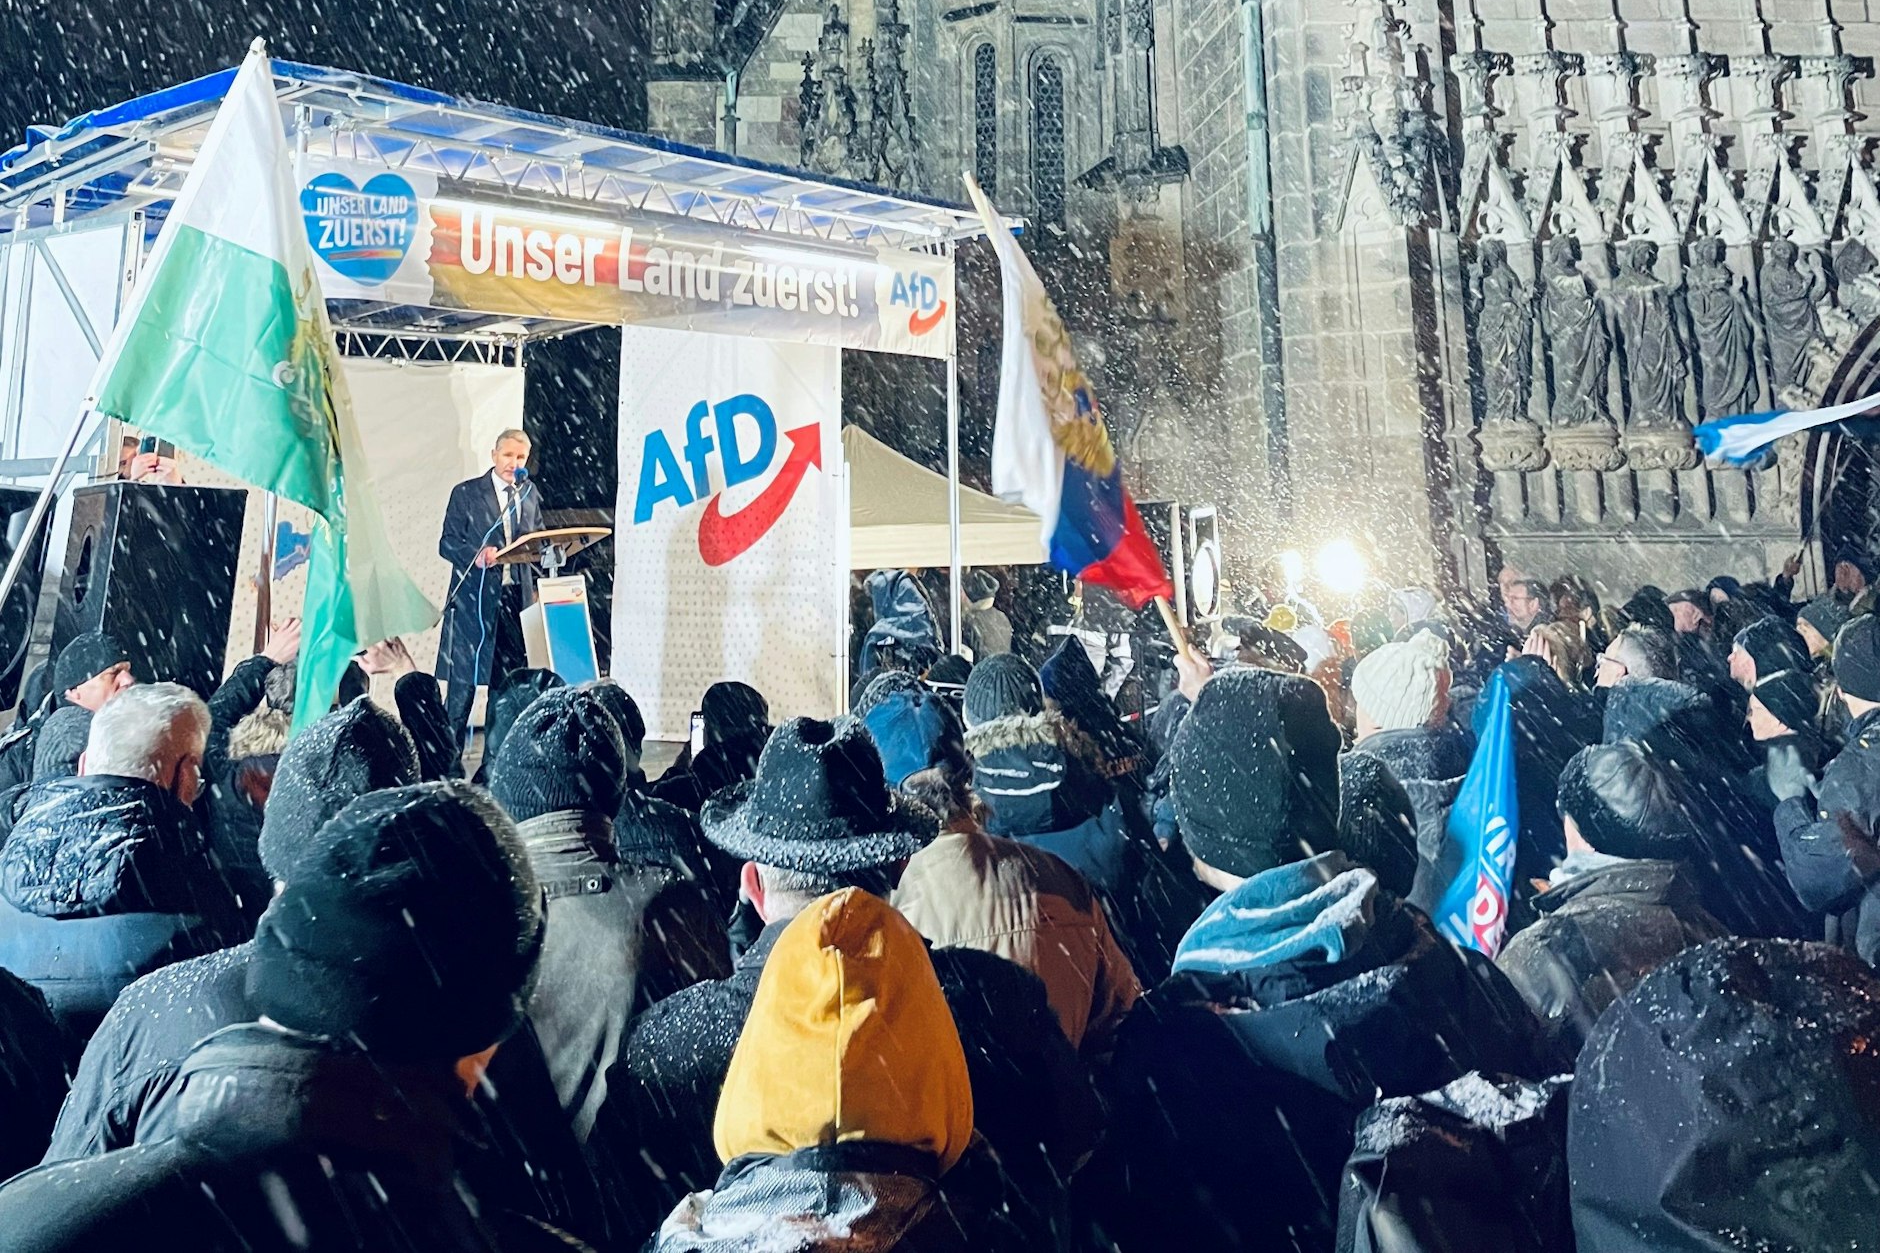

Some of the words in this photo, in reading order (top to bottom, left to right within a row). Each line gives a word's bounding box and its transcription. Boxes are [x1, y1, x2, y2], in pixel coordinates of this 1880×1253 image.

[316, 195, 366, 216] UNSER
[370, 195, 409, 215] LAND
[318, 217, 407, 249] ZUERST!
[460, 208, 605, 287] Unser
[618, 226, 723, 302] Land
[732, 258, 859, 318] zuerst!
[890, 270, 938, 312] AfD
[633, 393, 778, 525] AfD
